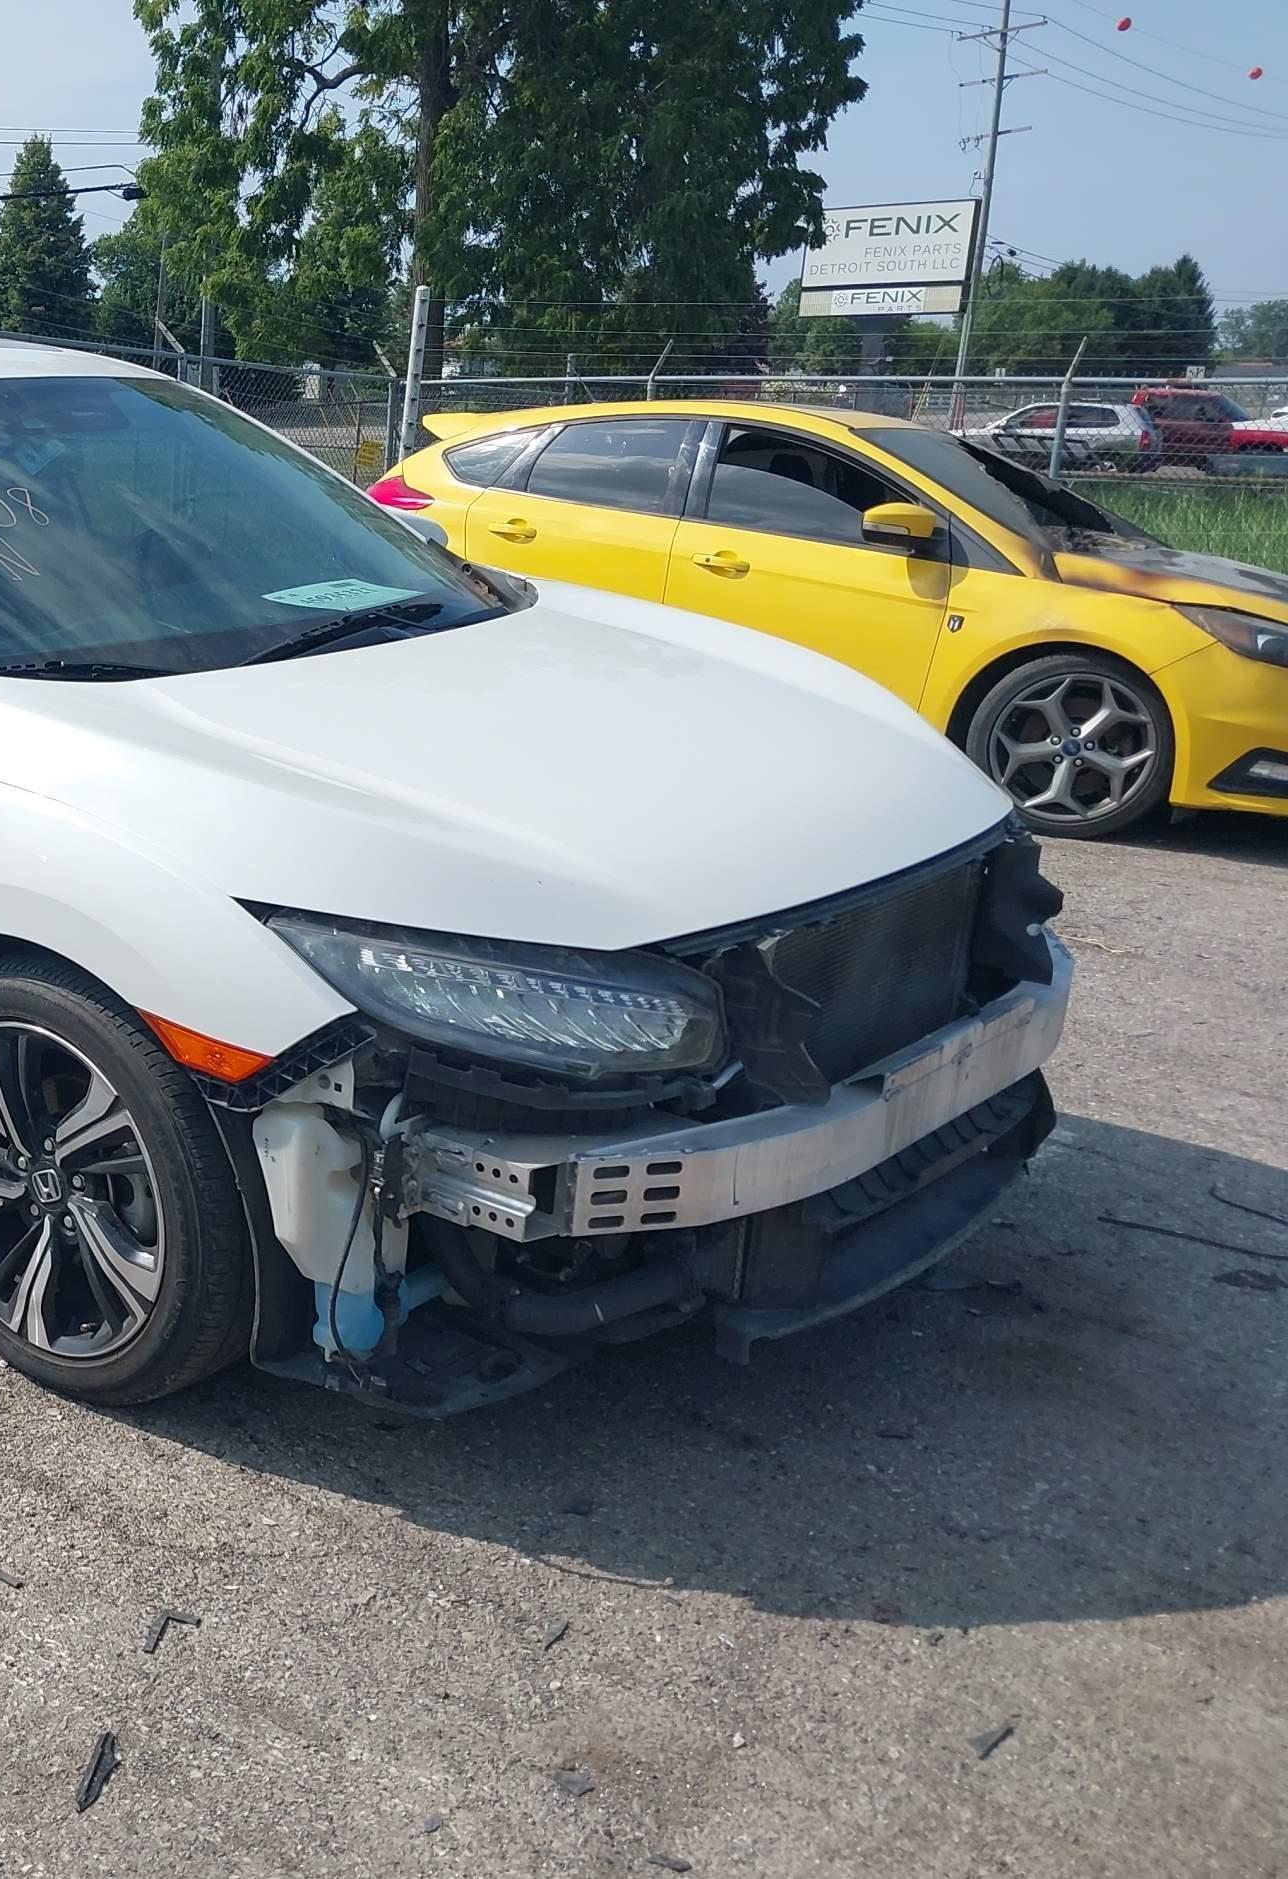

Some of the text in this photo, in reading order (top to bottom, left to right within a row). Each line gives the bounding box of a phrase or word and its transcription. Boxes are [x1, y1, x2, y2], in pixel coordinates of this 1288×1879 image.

[844, 213, 961, 238] FENIX
[864, 243, 961, 258] FENIX PARTS
[809, 257, 960, 276] DETROIT SOUTH LLC
[850, 289, 924, 304] FENIX
[877, 305, 922, 313] PARTS
